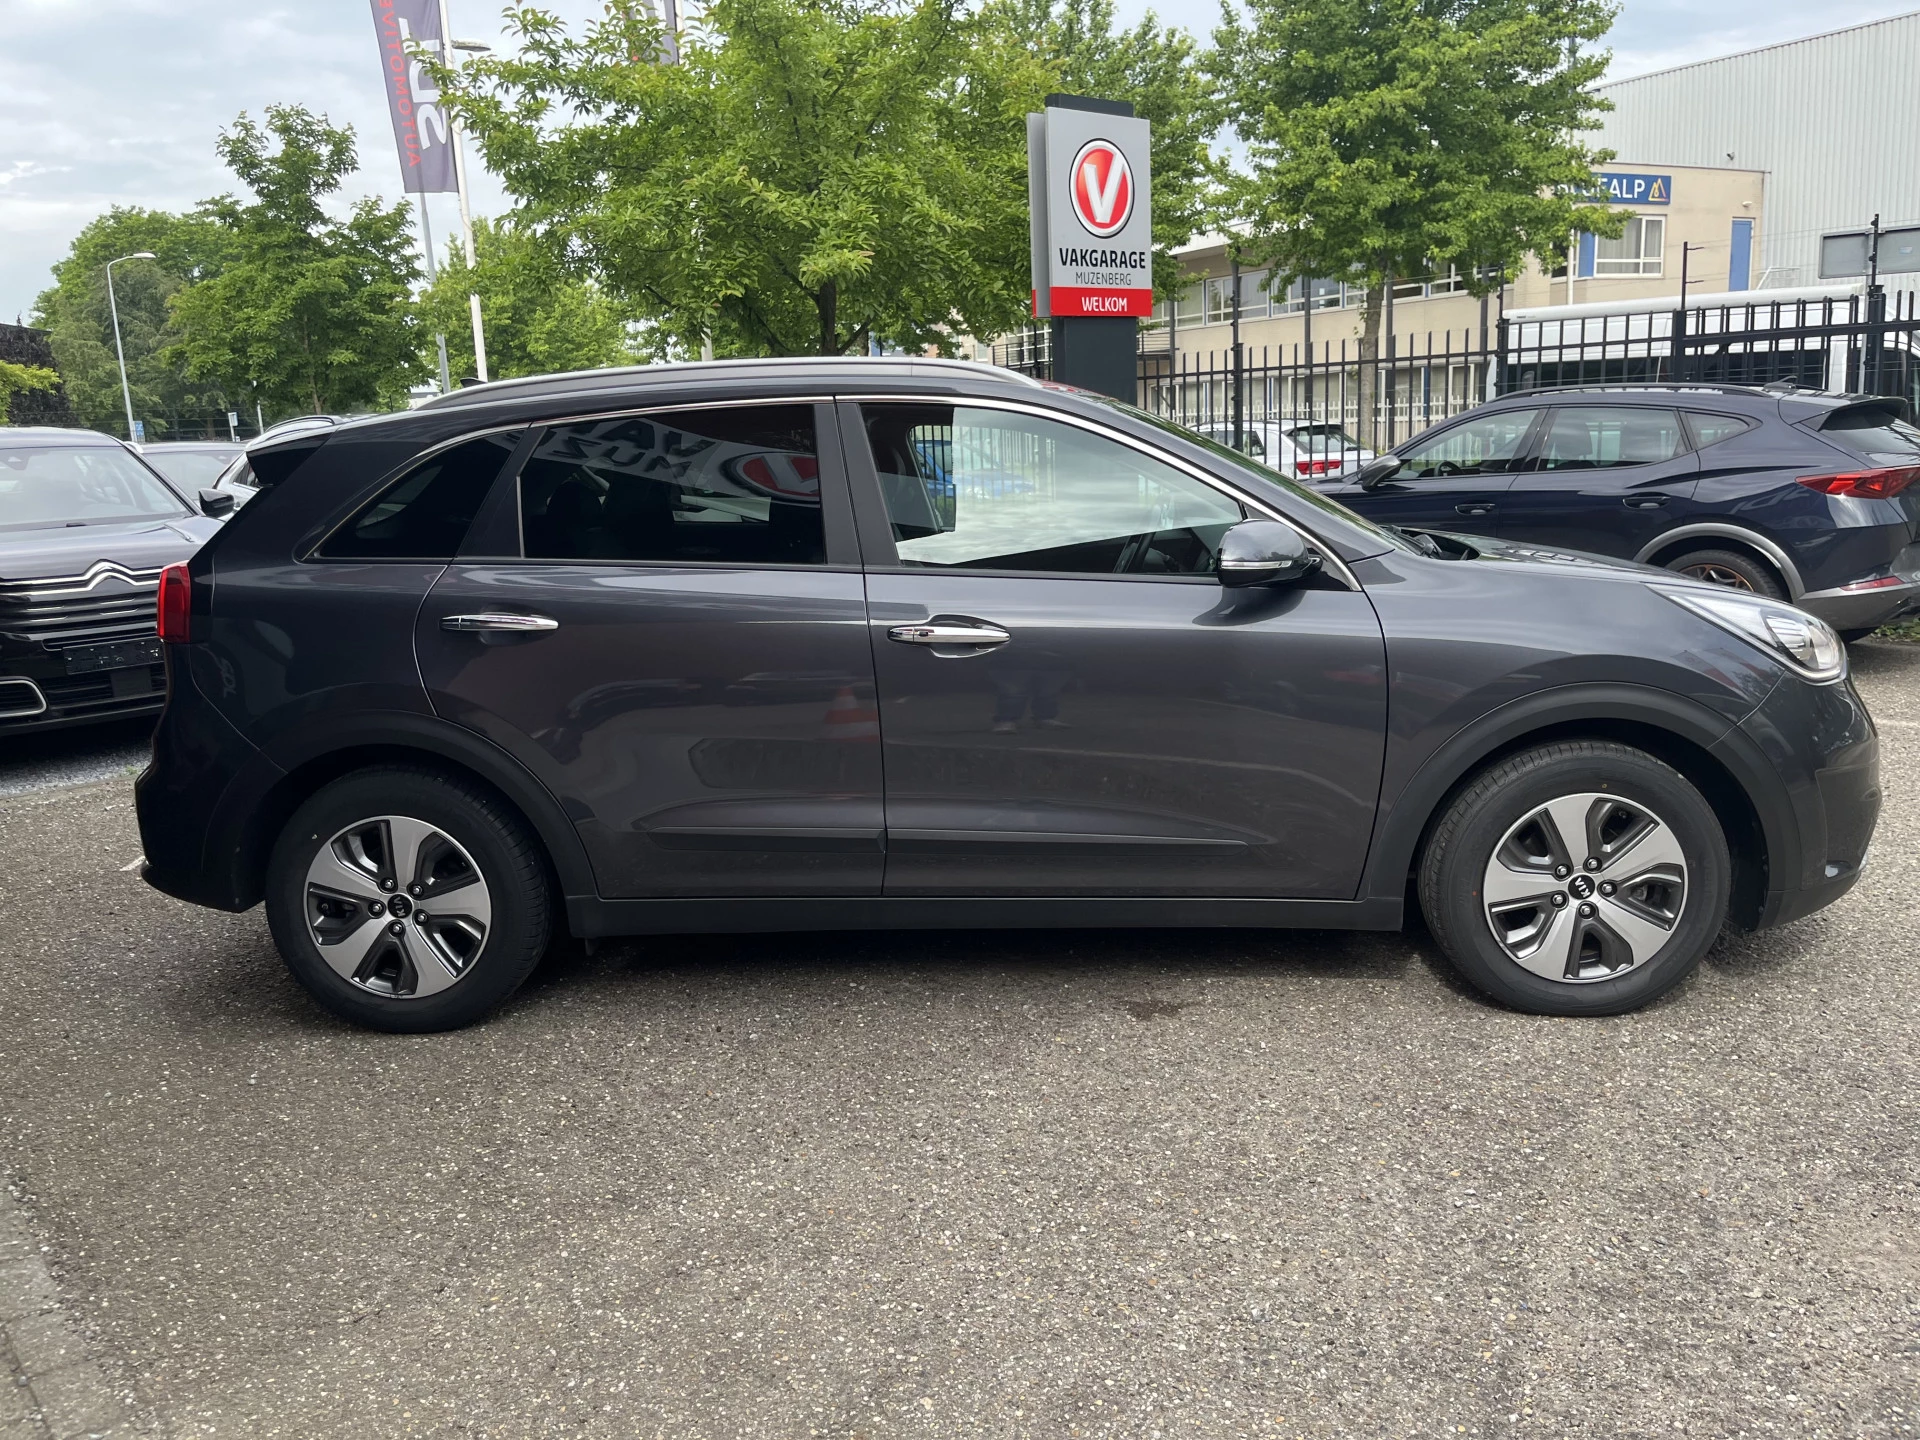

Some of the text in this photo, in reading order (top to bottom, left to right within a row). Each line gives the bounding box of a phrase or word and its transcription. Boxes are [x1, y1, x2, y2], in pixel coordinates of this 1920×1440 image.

[1083, 152, 1125, 223] V
[1059, 247, 1146, 269] VAKGARAGE
[1075, 271, 1132, 286] MUZENBERG
[1081, 296, 1128, 312] WELKOM
[1574, 877, 1590, 898] KIA
[394, 896, 405, 917] KIA
